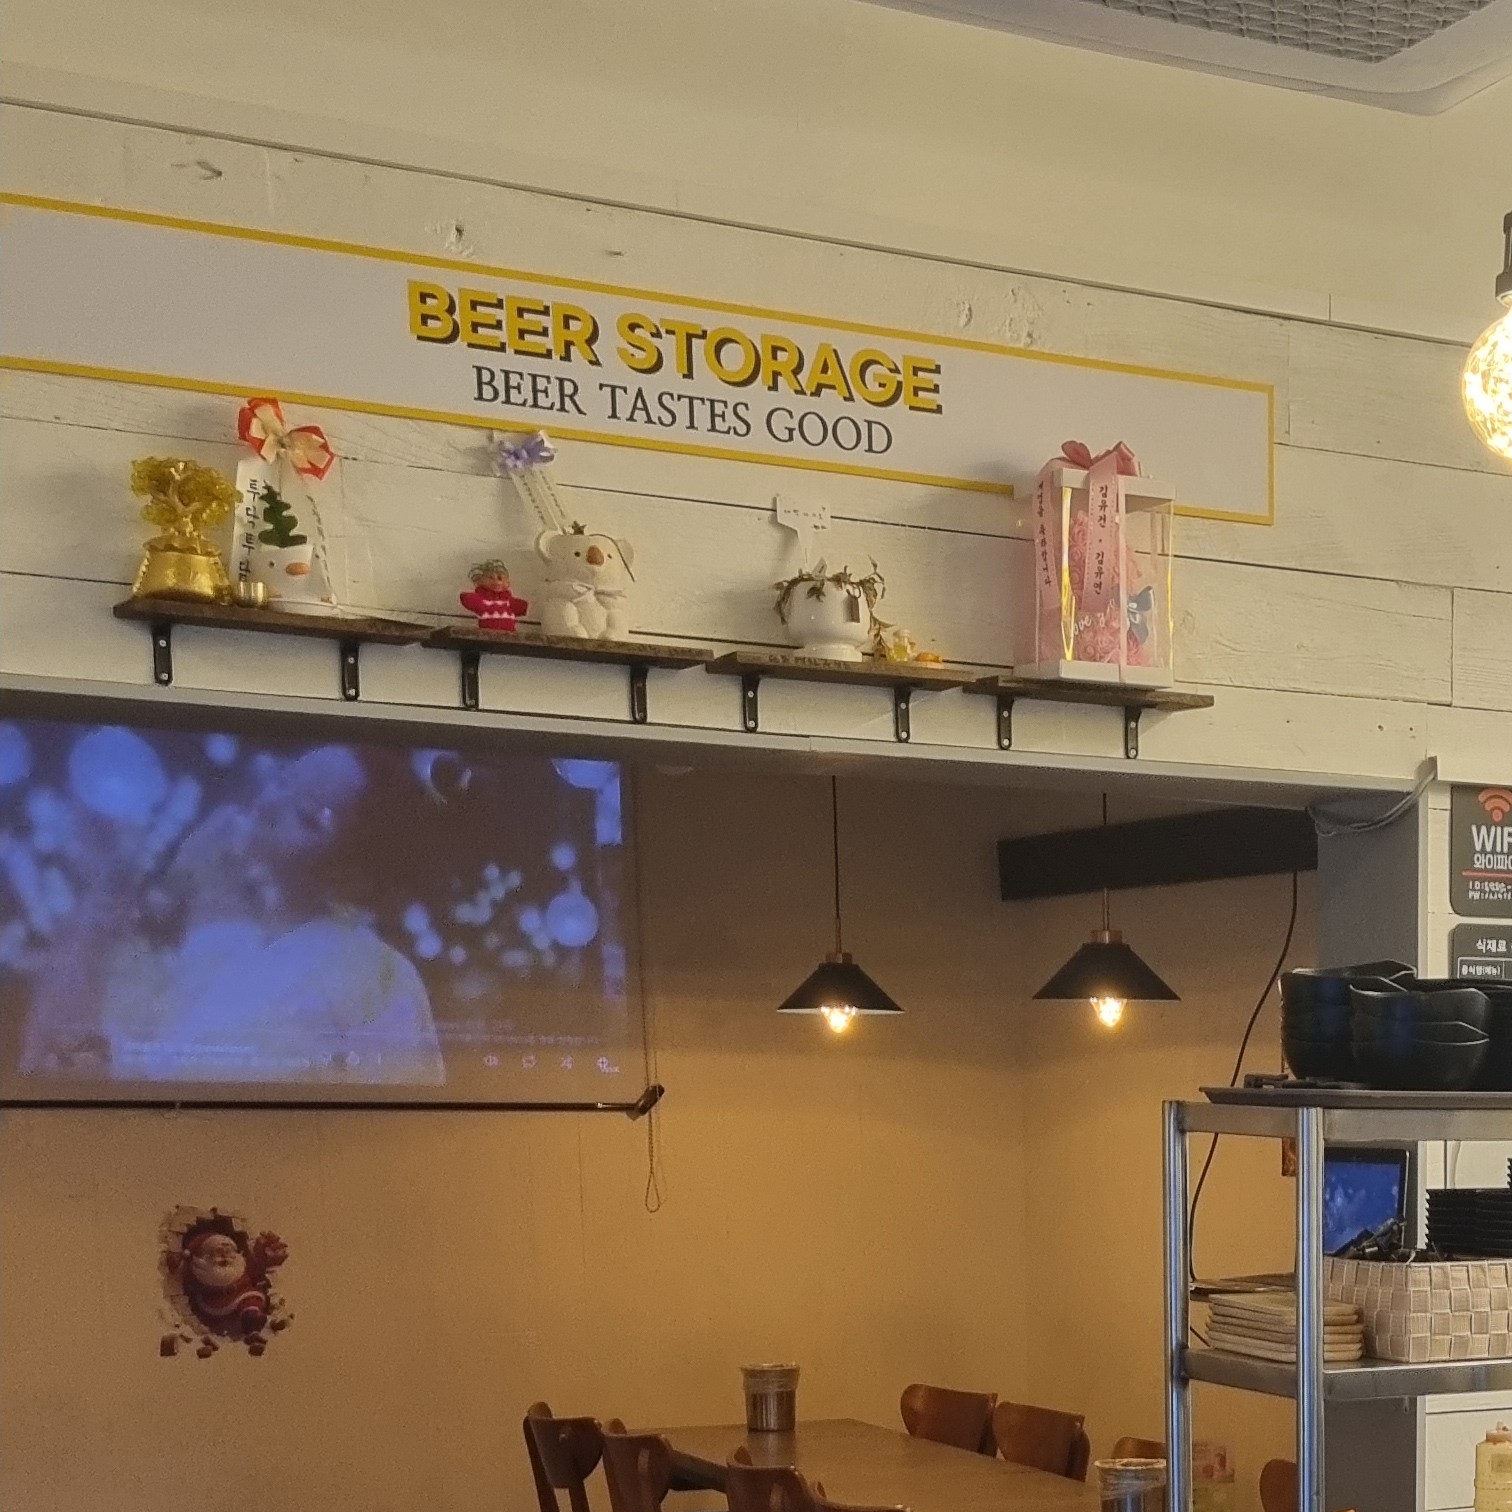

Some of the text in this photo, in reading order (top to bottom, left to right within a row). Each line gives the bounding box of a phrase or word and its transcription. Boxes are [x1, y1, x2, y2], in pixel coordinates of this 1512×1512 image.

[407, 280, 943, 415] BEER STORAGE
[472, 365, 892, 455] BEER TASTES GOOD
[1476, 938, 1507, 952] 식재료
